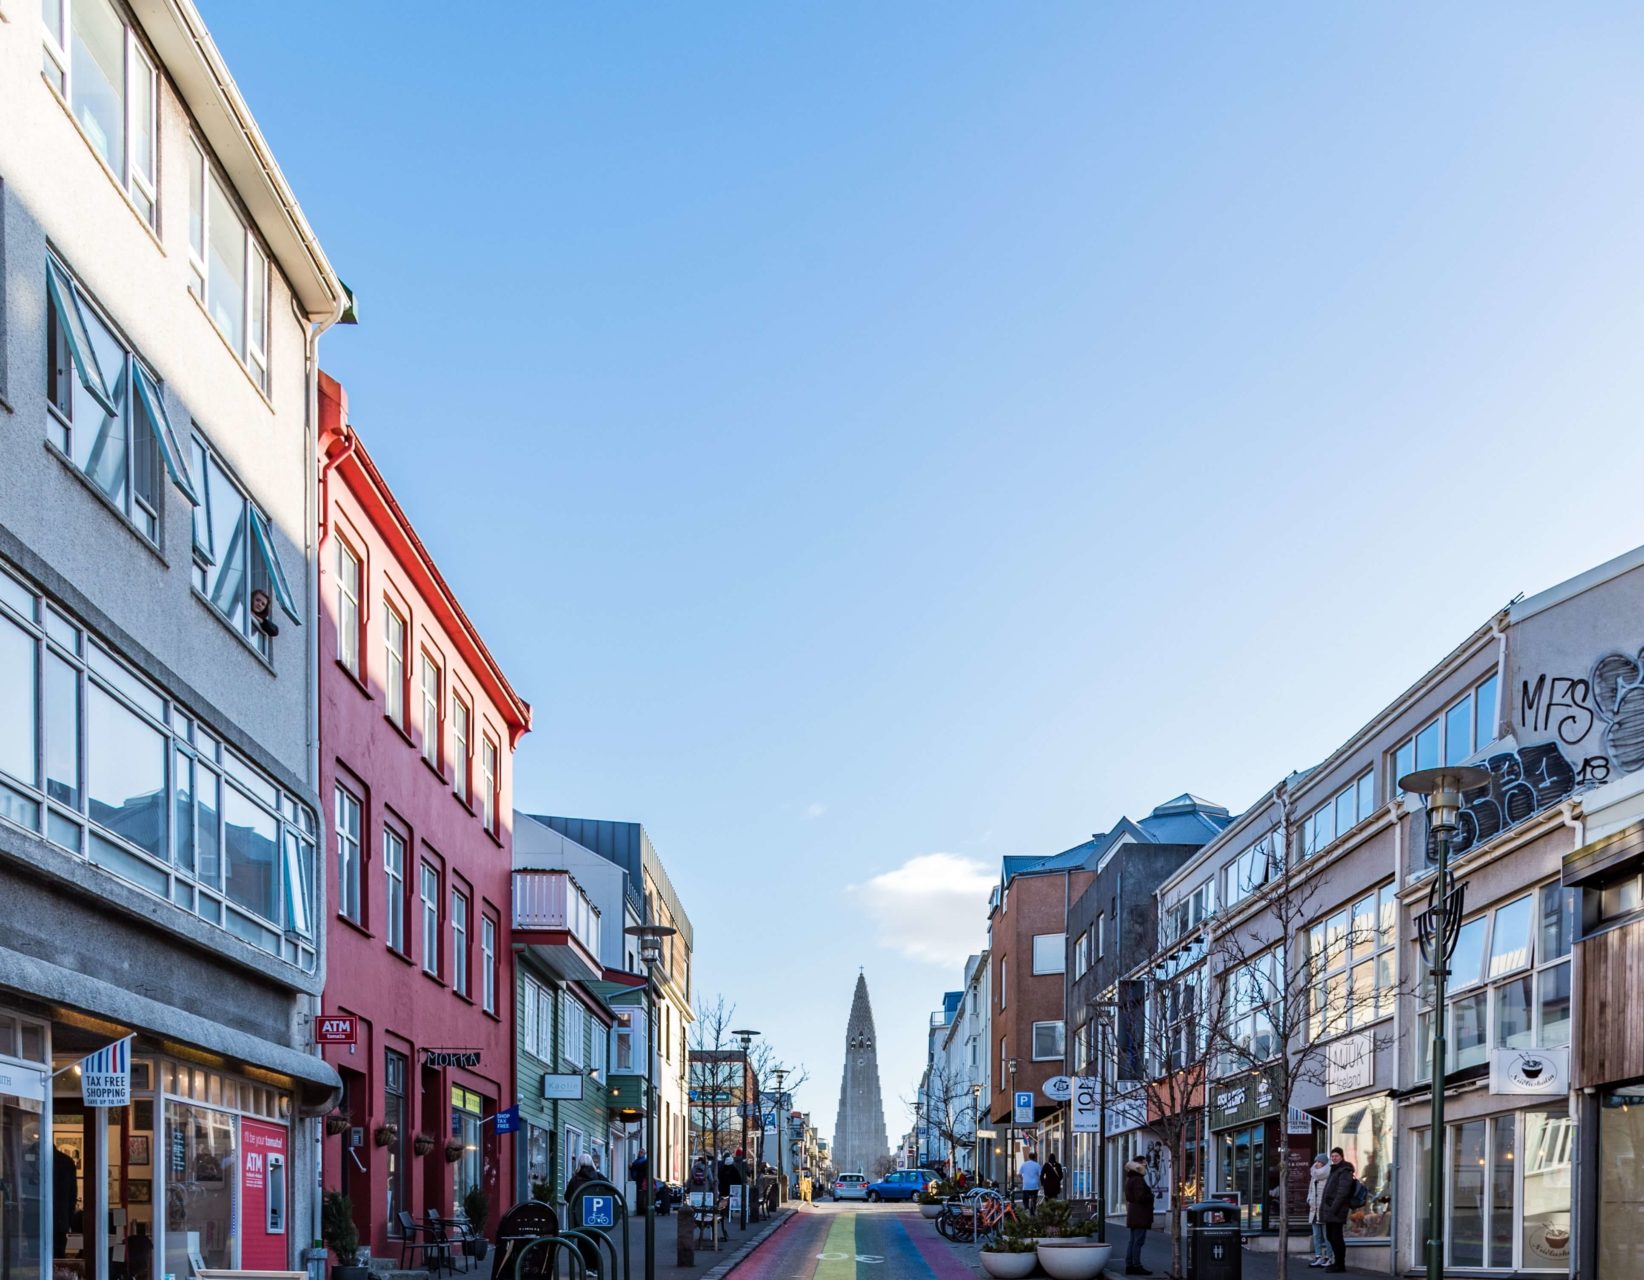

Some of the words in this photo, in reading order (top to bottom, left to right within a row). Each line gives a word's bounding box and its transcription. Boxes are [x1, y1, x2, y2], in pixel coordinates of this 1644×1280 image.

[322, 1020, 351, 1033] ATM
[427, 1051, 479, 1068] MOKKA
[86, 1075, 101, 1087] TAX
[104, 1076, 126, 1087] FREE
[86, 1087, 126, 1098] SHOPPING
[1020, 1095, 1028, 1106] P
[246, 1151, 263, 1173] ATM
[593, 1198, 604, 1212] P
